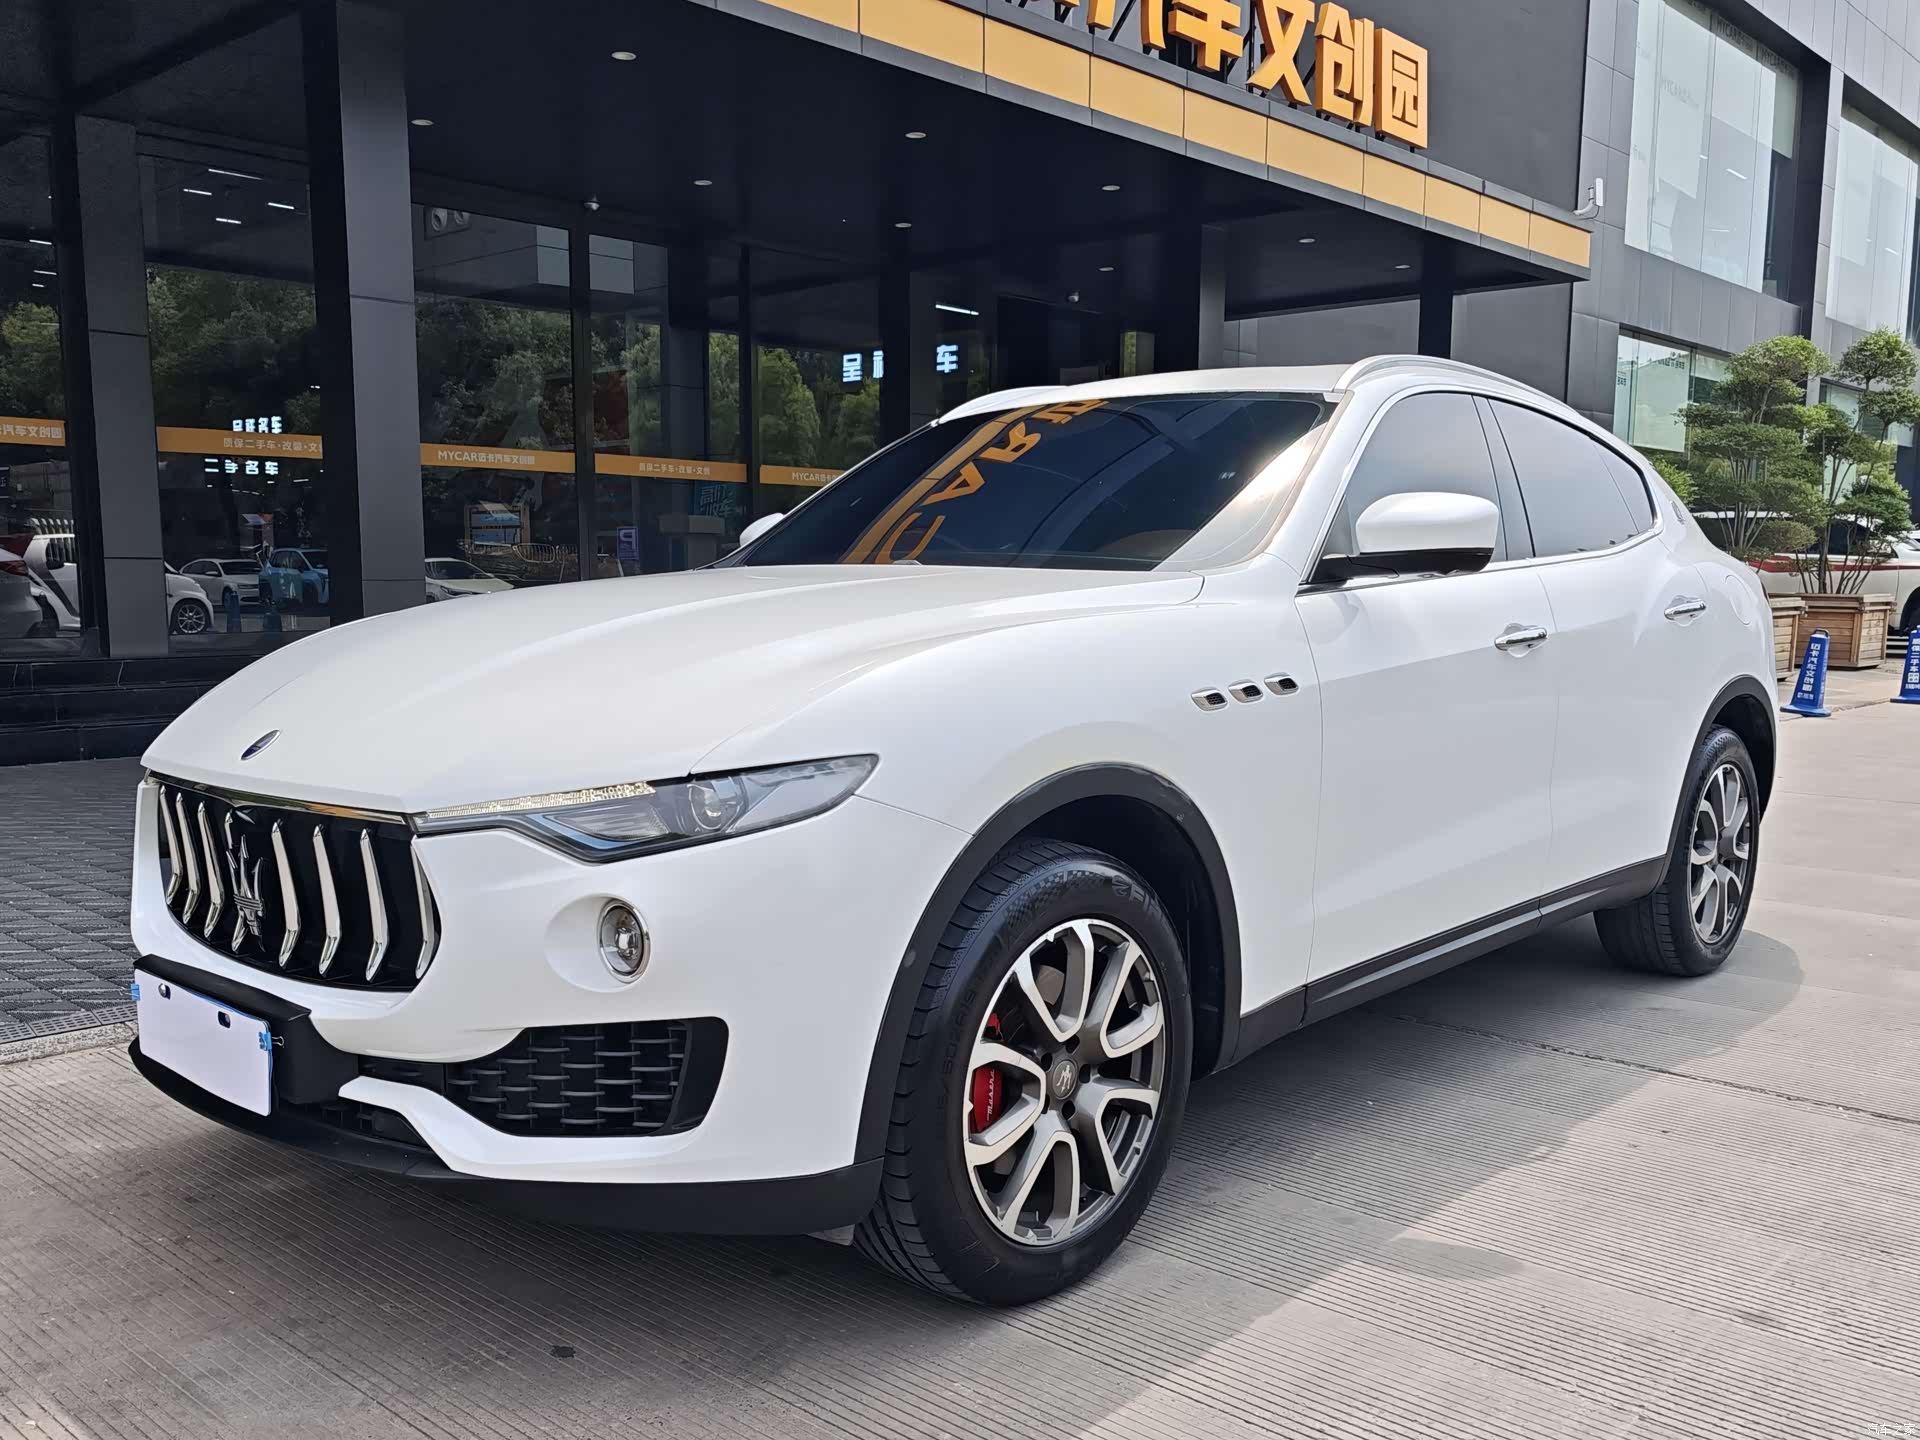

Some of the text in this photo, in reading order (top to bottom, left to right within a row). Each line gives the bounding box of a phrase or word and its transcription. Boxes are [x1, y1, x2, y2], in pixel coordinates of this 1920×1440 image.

[0, 423, 62, 439] 汽车文创园
